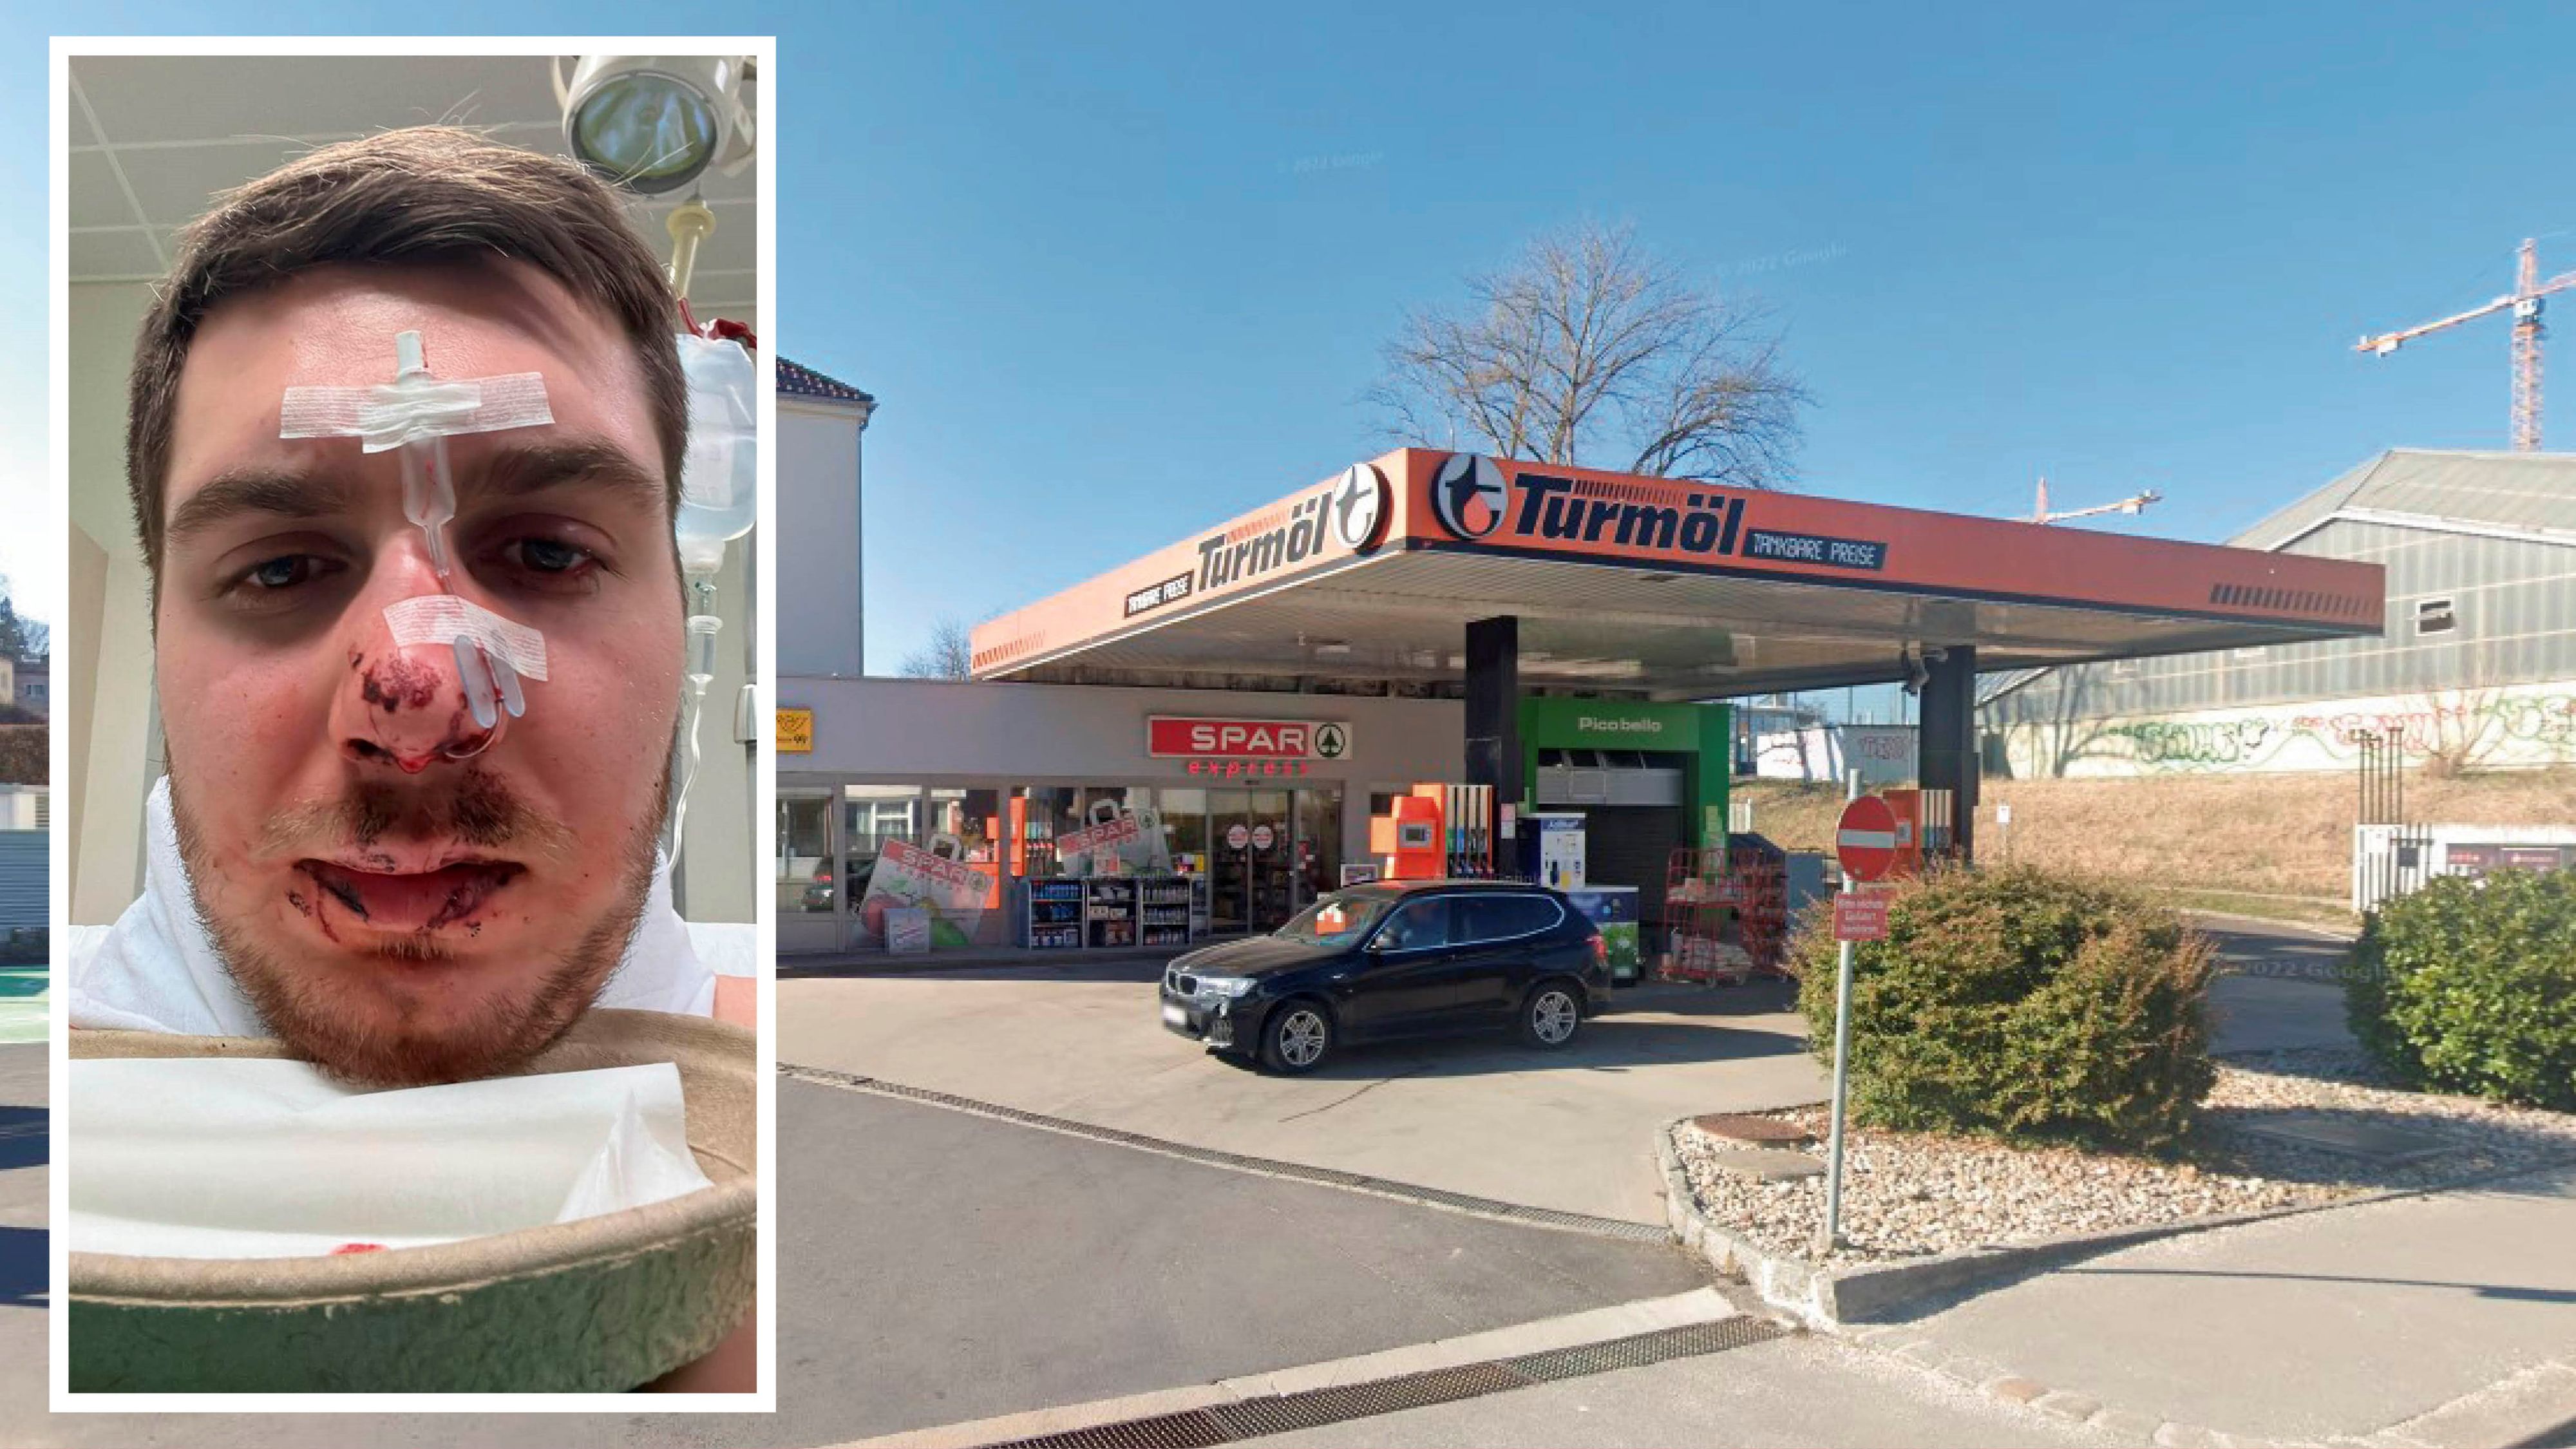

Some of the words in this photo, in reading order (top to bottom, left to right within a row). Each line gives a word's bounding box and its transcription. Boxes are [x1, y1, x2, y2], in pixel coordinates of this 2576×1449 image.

[1515, 473, 1746, 555] Turmöl
[1198, 491, 1333, 592] Turmöl
[1754, 533, 1823, 560] TANKBARE
[1830, 542, 1877, 565] PREISE
[1191, 726, 1305, 752] SPAR
[1577, 717, 1662, 732] Picobello
[1188, 761, 1308, 779] express
[1079, 819, 1136, 848] SPAR
[902, 848, 966, 886] SPAR
